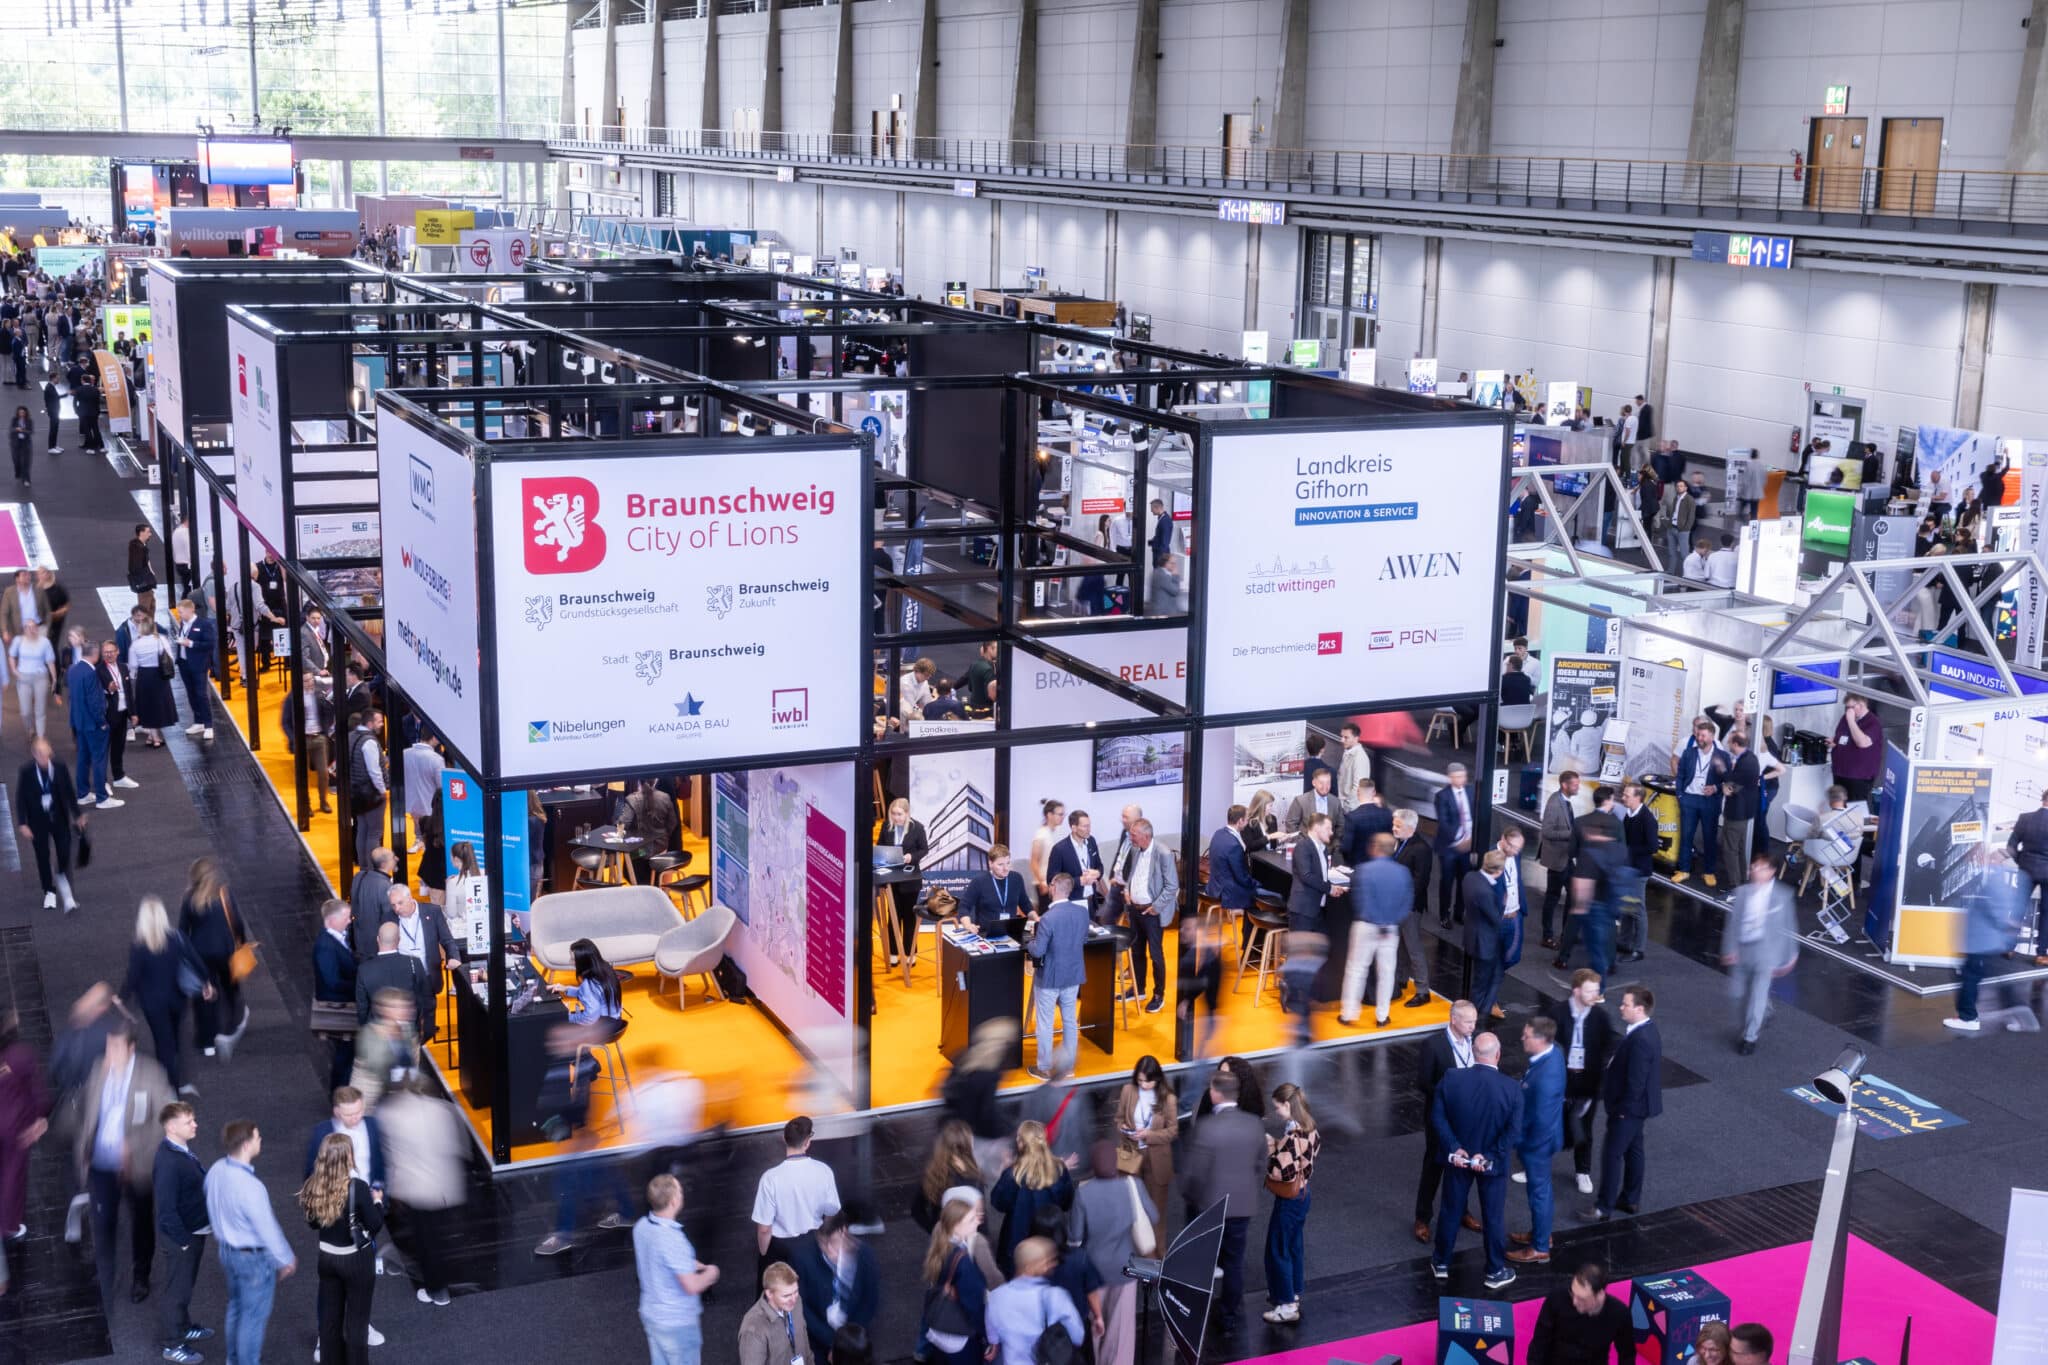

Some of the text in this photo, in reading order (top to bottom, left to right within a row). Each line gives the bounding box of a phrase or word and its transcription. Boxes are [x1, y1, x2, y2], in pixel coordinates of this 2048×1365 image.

[1775, 244, 1785, 262] 5
[1296, 453, 1393, 476] Landkreis
[412, 469, 432, 503] WMG
[1295, 479, 1369, 500] Gifhorn
[627, 484, 835, 518] Braunschweig
[1299, 506, 1414, 521] INNOVATION & SERVICE
[627, 520, 799, 556] City of Lions
[1378, 552, 1463, 581] AWEN
[739, 579, 830, 595] Braunschweig
[559, 589, 655, 606] Braunschweig
[739, 597, 776, 609] Zukunft
[560, 602, 679, 620] Grundstücksgesellschaft
[1399, 629, 1438, 646] PGN
[602, 643, 766, 665] Stadt Braunschweig
[1232, 647, 1249, 657] Die
[1250, 642, 1317, 656] Planschmiede
[1119, 662, 1168, 683] REAL
[1940, 664, 1961, 679] BAU
[772, 706, 802, 724] iwb
[1994, 710, 2014, 721] BAU
[552, 718, 626, 734] Nibelungen
[649, 718, 730, 734] KANADA BAU
[919, 726, 958, 734] Landkreis
[473, 885, 481, 897] F
[475, 922, 483, 934] F
[1878, 1096, 1922, 1117] Halle
[1700, 1313, 1721, 1322] REAL
